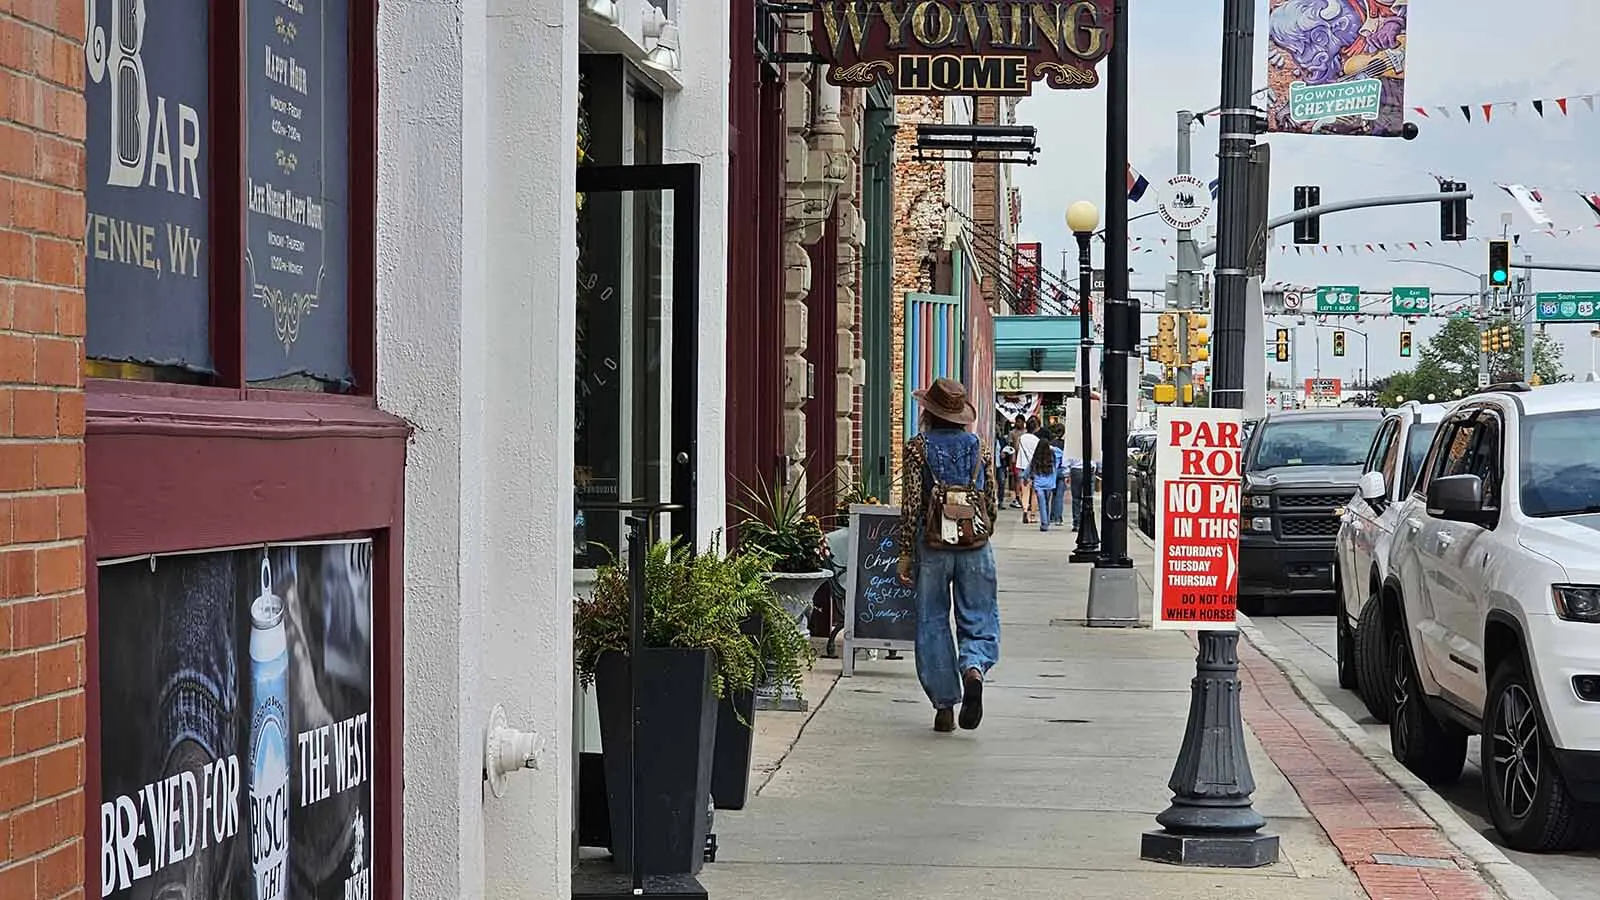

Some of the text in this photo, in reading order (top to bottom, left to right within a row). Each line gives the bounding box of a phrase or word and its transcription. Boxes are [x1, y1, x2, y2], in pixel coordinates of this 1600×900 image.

[818, 0, 1105, 57] WYOMING
[265, 44, 308, 96] HAPPY HOUR
[898, 55, 1028, 91] HOME
[1294, 83, 1378, 103] DOWNTOWN
[1294, 94, 1377, 117] CHEYENNE
[248, 178, 323, 230] LATE NIGHT HAPPY HOUR
[1580, 304, 1592, 313] 85
[1169, 421, 1241, 448] PAR
[1169, 483, 1202, 514] NO
[1174, 518, 1238, 539] IN THIS
[1168, 545, 1223, 557] SATURDAYS
[1168, 560, 1211, 572] TUESDAY
[1168, 575, 1218, 587] THURSDAY
[1182, 594, 1196, 605] DO
[1199, 594, 1218, 605] NOT
[1167, 608, 1196, 619] WHEN
[298, 712, 368, 808] THE WEST
[101, 754, 240, 898] BREWED FOR
[249, 783, 288, 866] BUSCH
